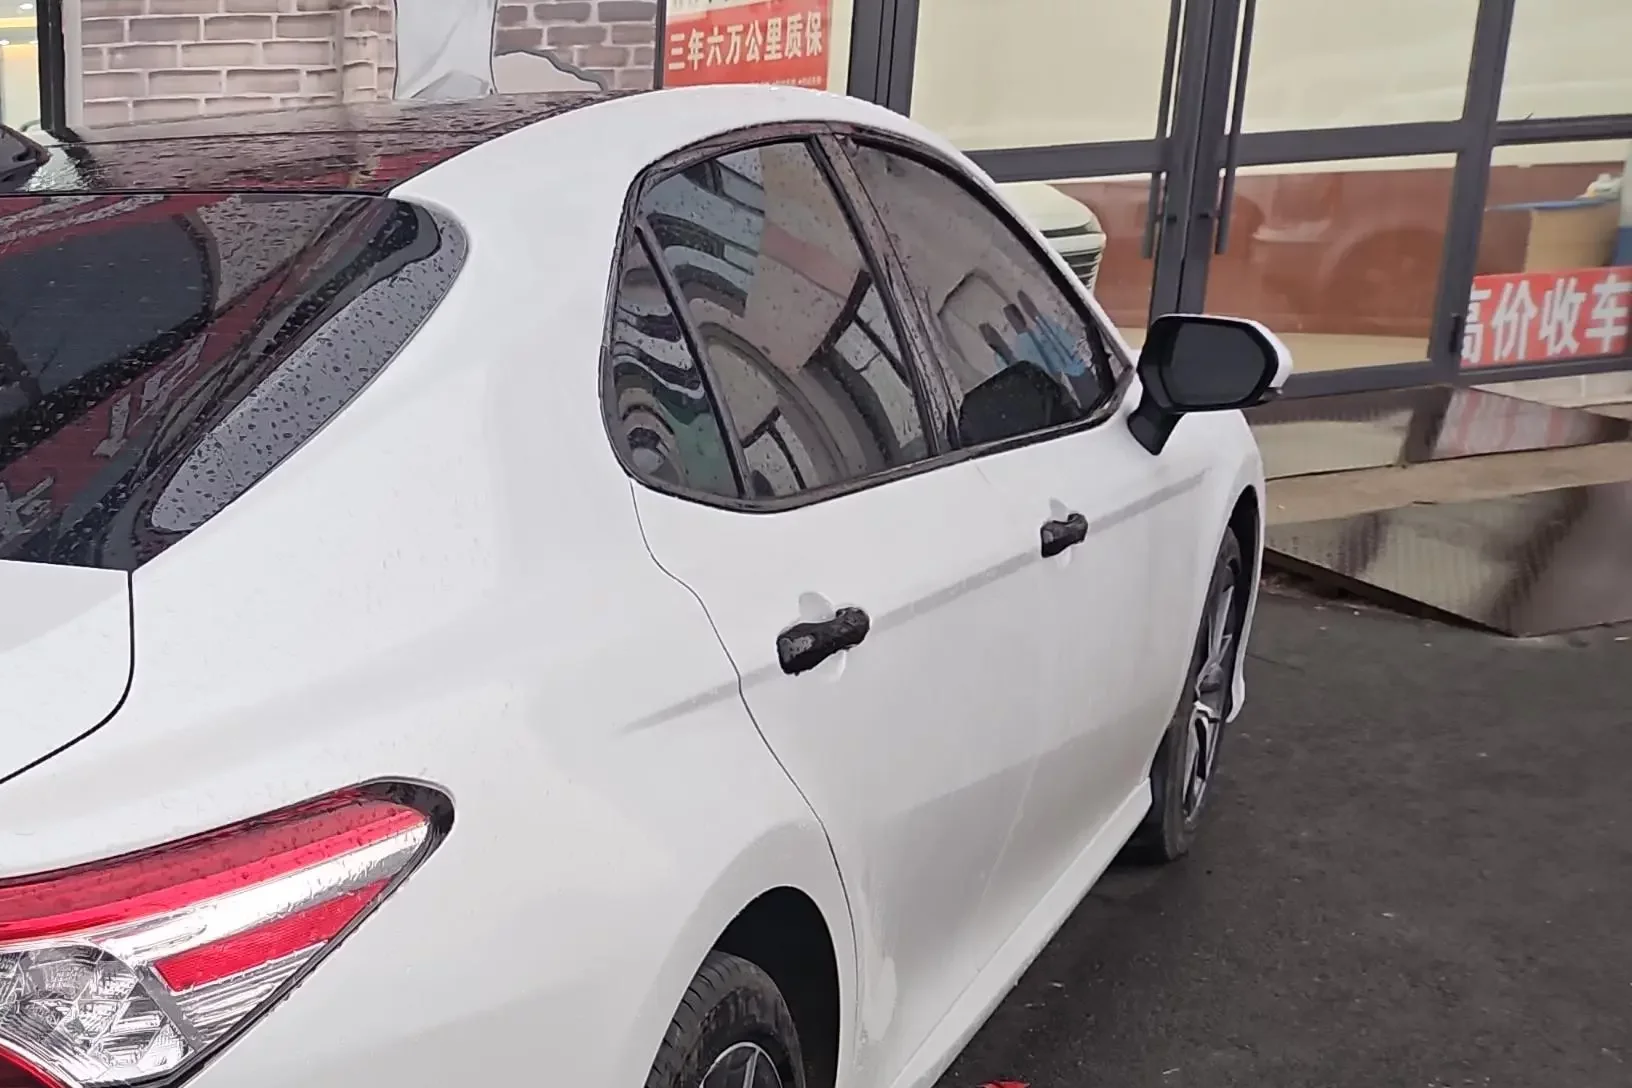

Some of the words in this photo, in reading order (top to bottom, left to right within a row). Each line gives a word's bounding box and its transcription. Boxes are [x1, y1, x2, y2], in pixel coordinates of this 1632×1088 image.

[669, 11, 822, 71] 三年六万公里质保
